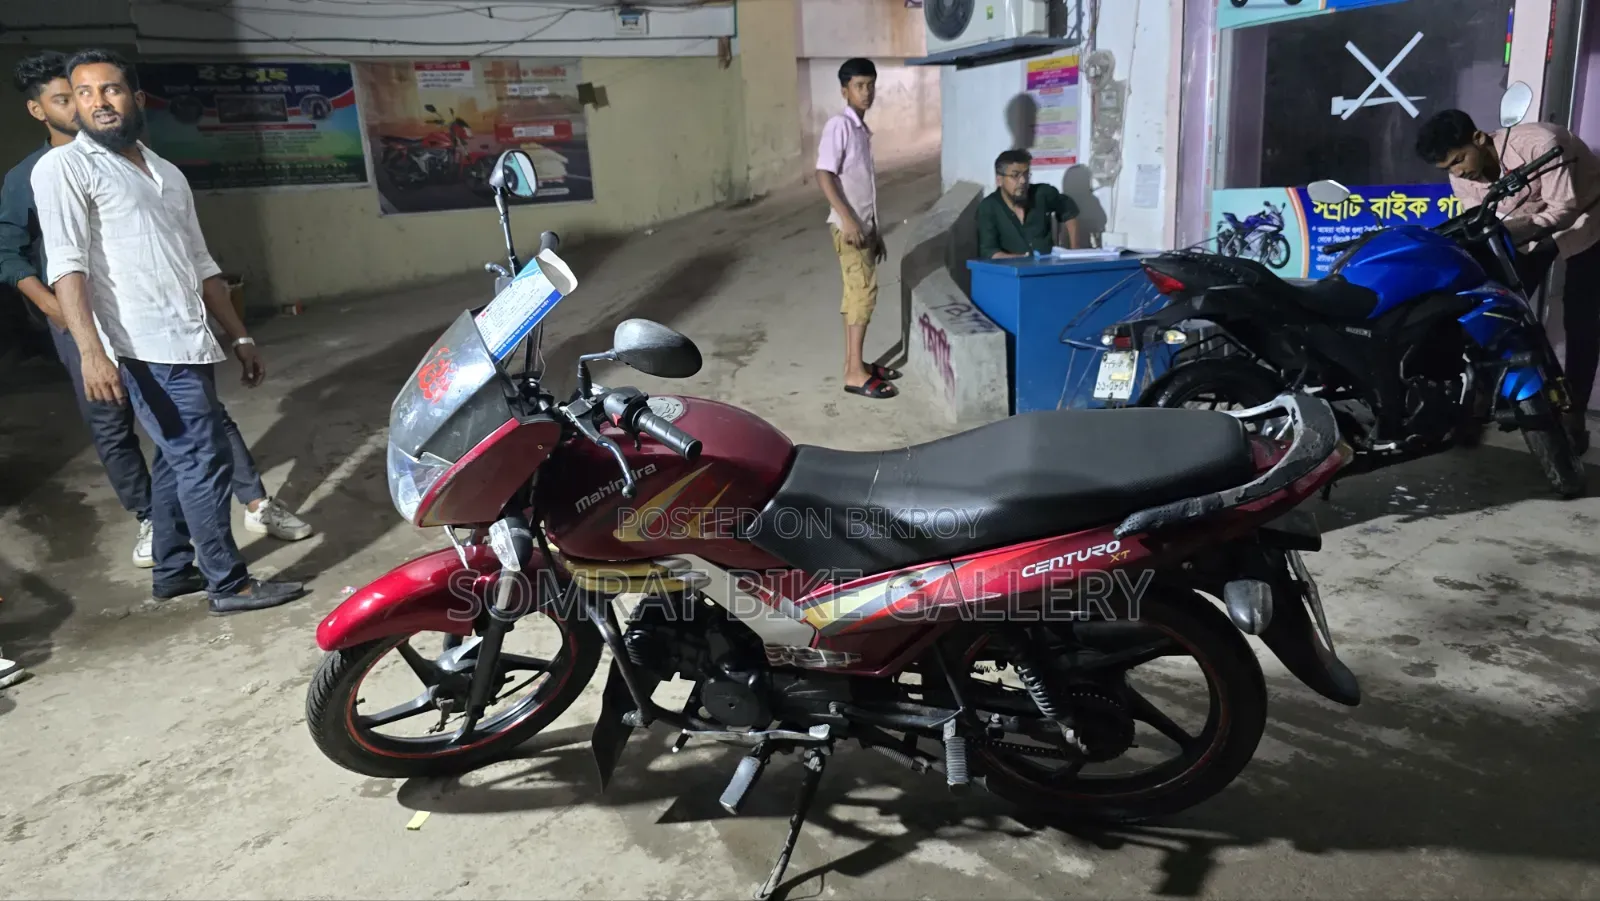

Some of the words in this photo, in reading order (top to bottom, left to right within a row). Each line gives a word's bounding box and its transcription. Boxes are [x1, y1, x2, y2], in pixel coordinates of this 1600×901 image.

[1369, 190, 1431, 222] বাইক
[1021, 540, 1121, 578] CENTURO
[1109, 549, 1131, 563] XT
